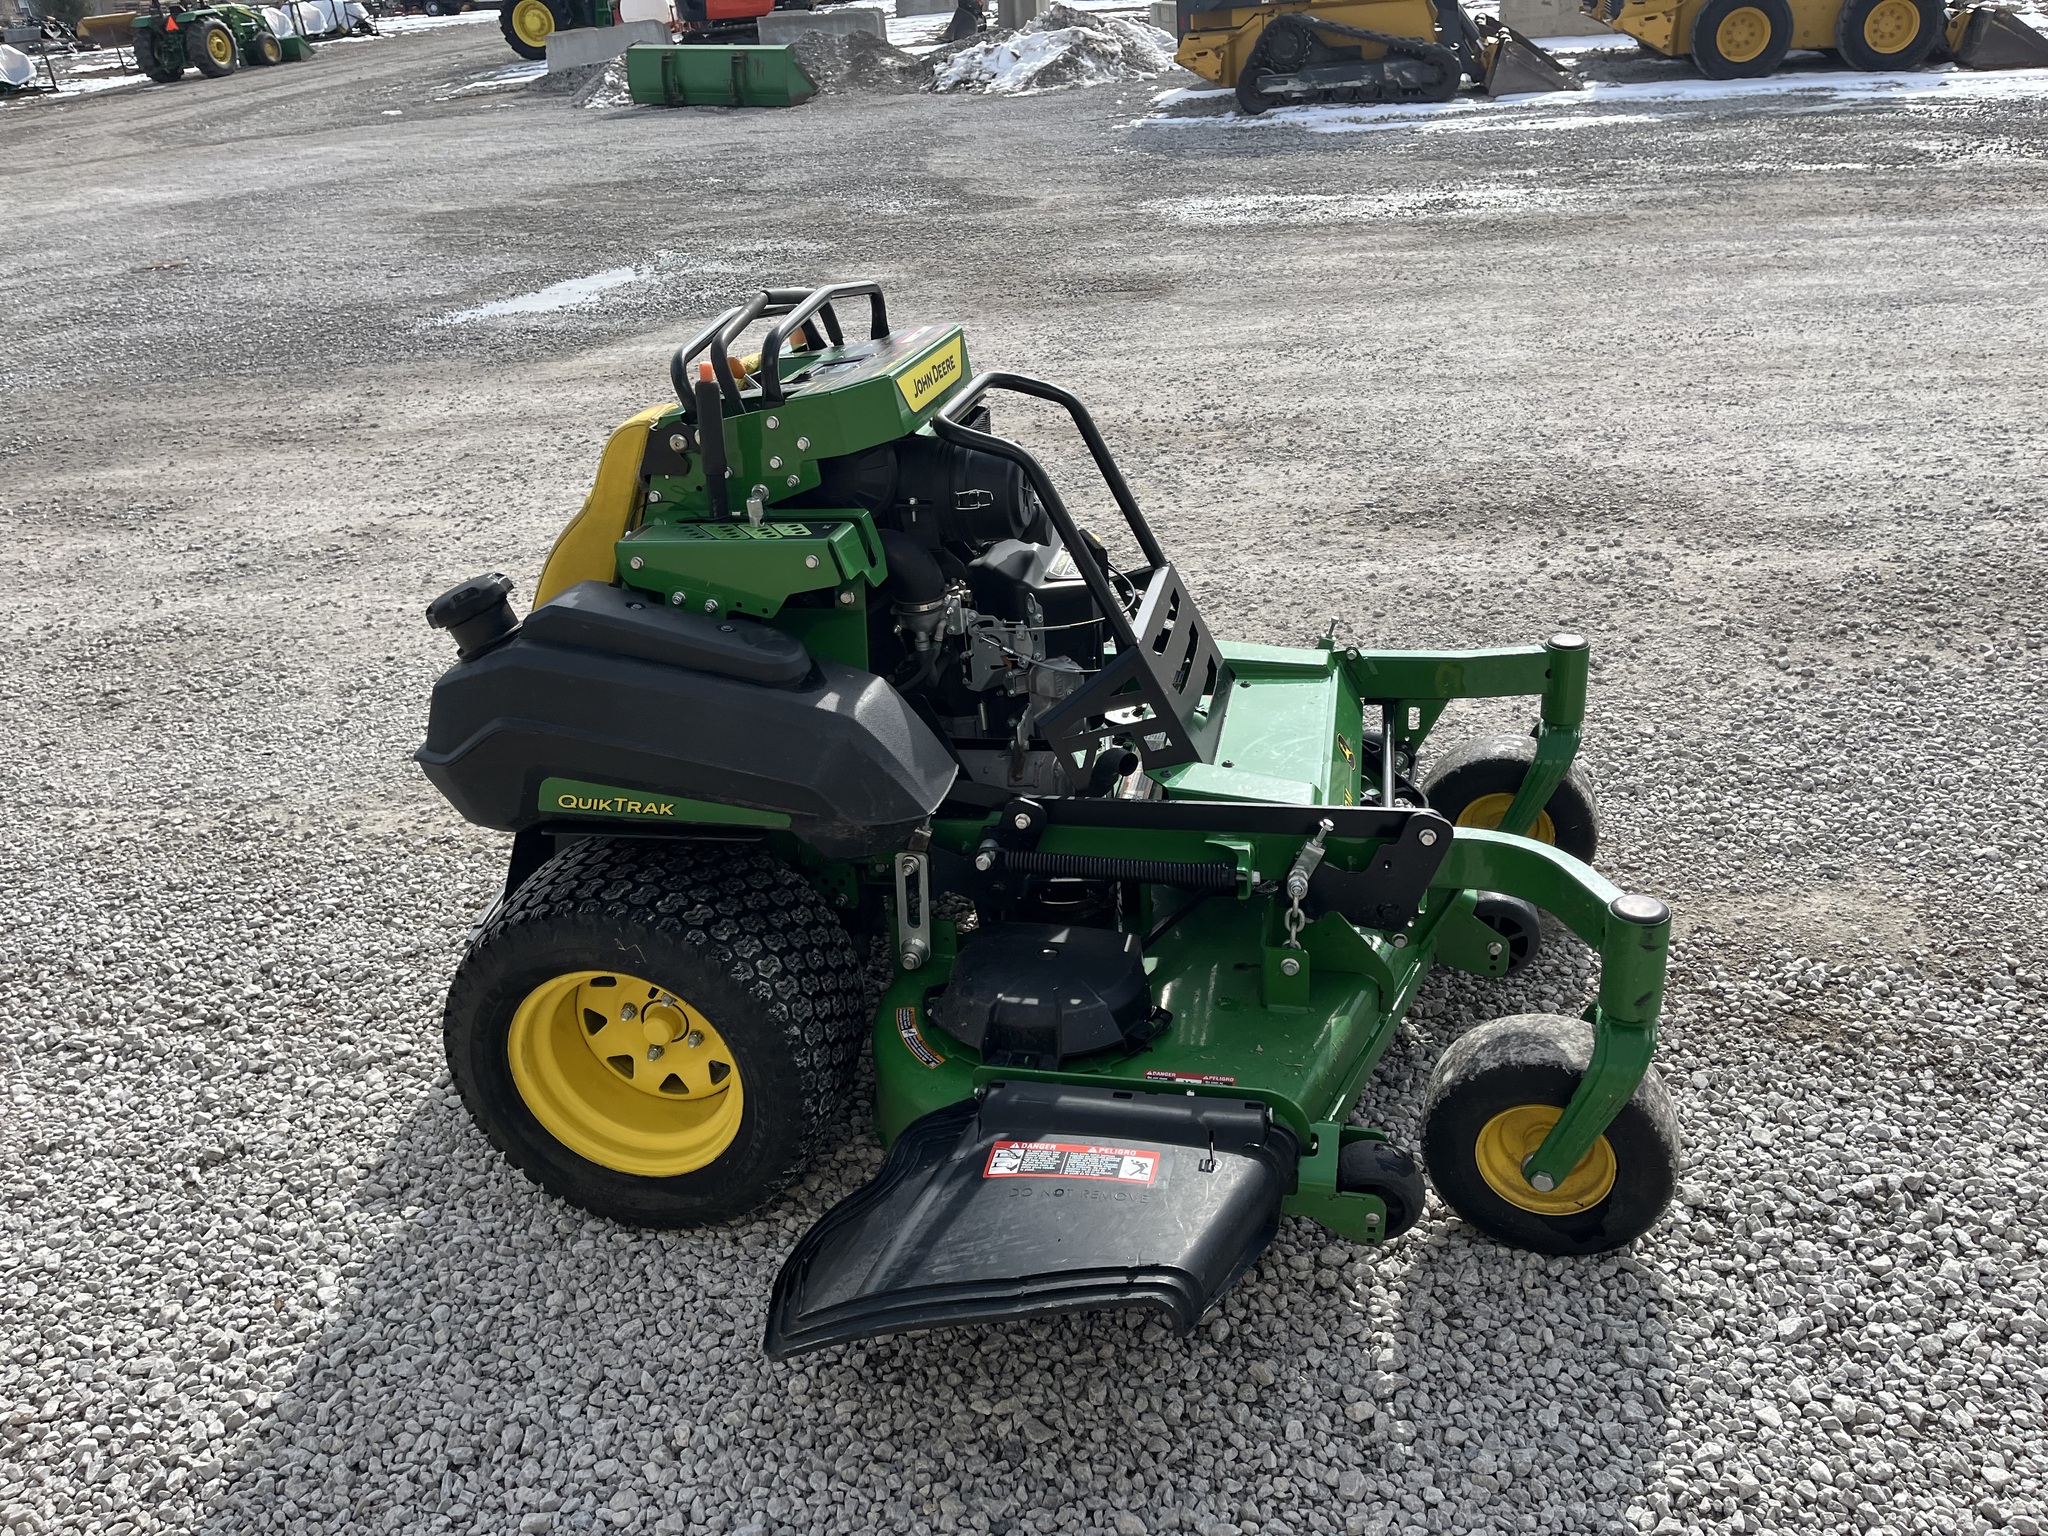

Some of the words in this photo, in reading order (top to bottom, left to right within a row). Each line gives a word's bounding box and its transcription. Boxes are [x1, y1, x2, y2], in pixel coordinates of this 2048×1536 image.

[913, 370, 934, 398] JOHN
[932, 355, 956, 383] DEERE
[1021, 1142, 1057, 1150] DANGER
[1098, 1147, 1137, 1156] PELIGRO
[1009, 1187, 1033, 1198] DO
[1041, 1188, 1074, 1198] NOT
[1080, 1189, 1151, 1204] REMOVE
